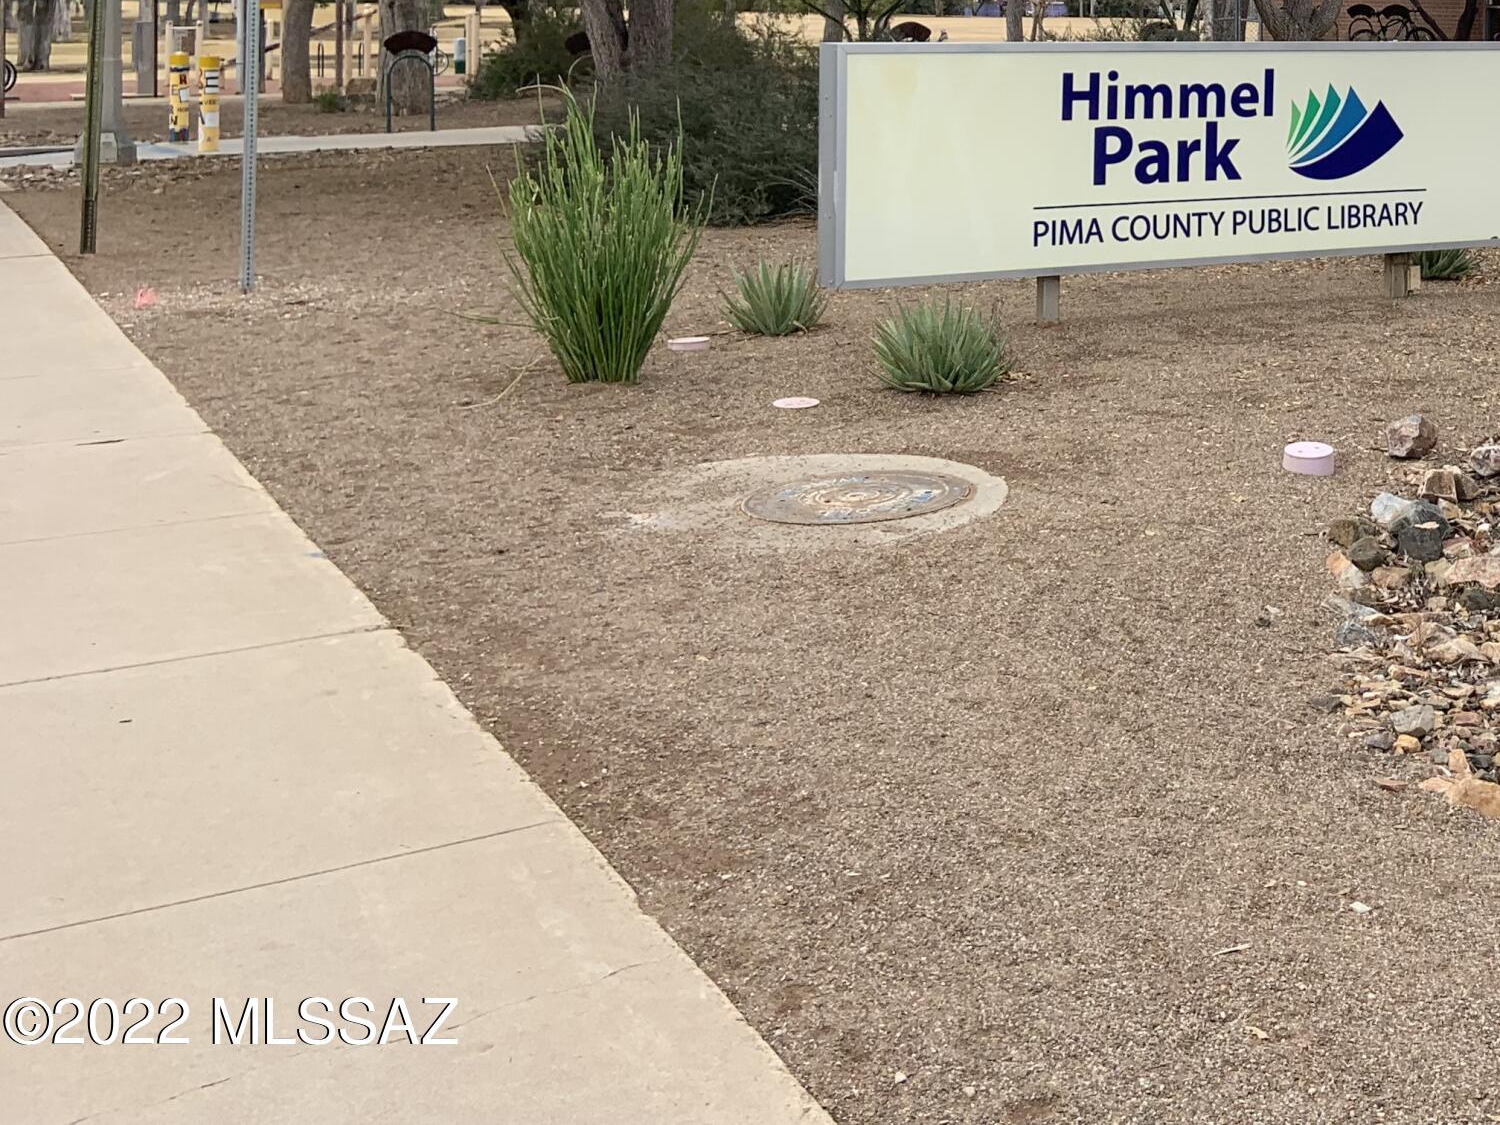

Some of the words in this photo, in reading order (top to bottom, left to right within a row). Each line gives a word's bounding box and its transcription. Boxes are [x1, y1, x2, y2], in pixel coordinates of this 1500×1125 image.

[1061, 68, 1275, 121] Himmel
[1092, 121, 1242, 186] Park
[1032, 218, 1104, 247] PIMA
[1111, 211, 1226, 241] COUNTY
[1232, 206, 1319, 235] PUBLIC
[1326, 201, 1424, 230] LIBRARY
